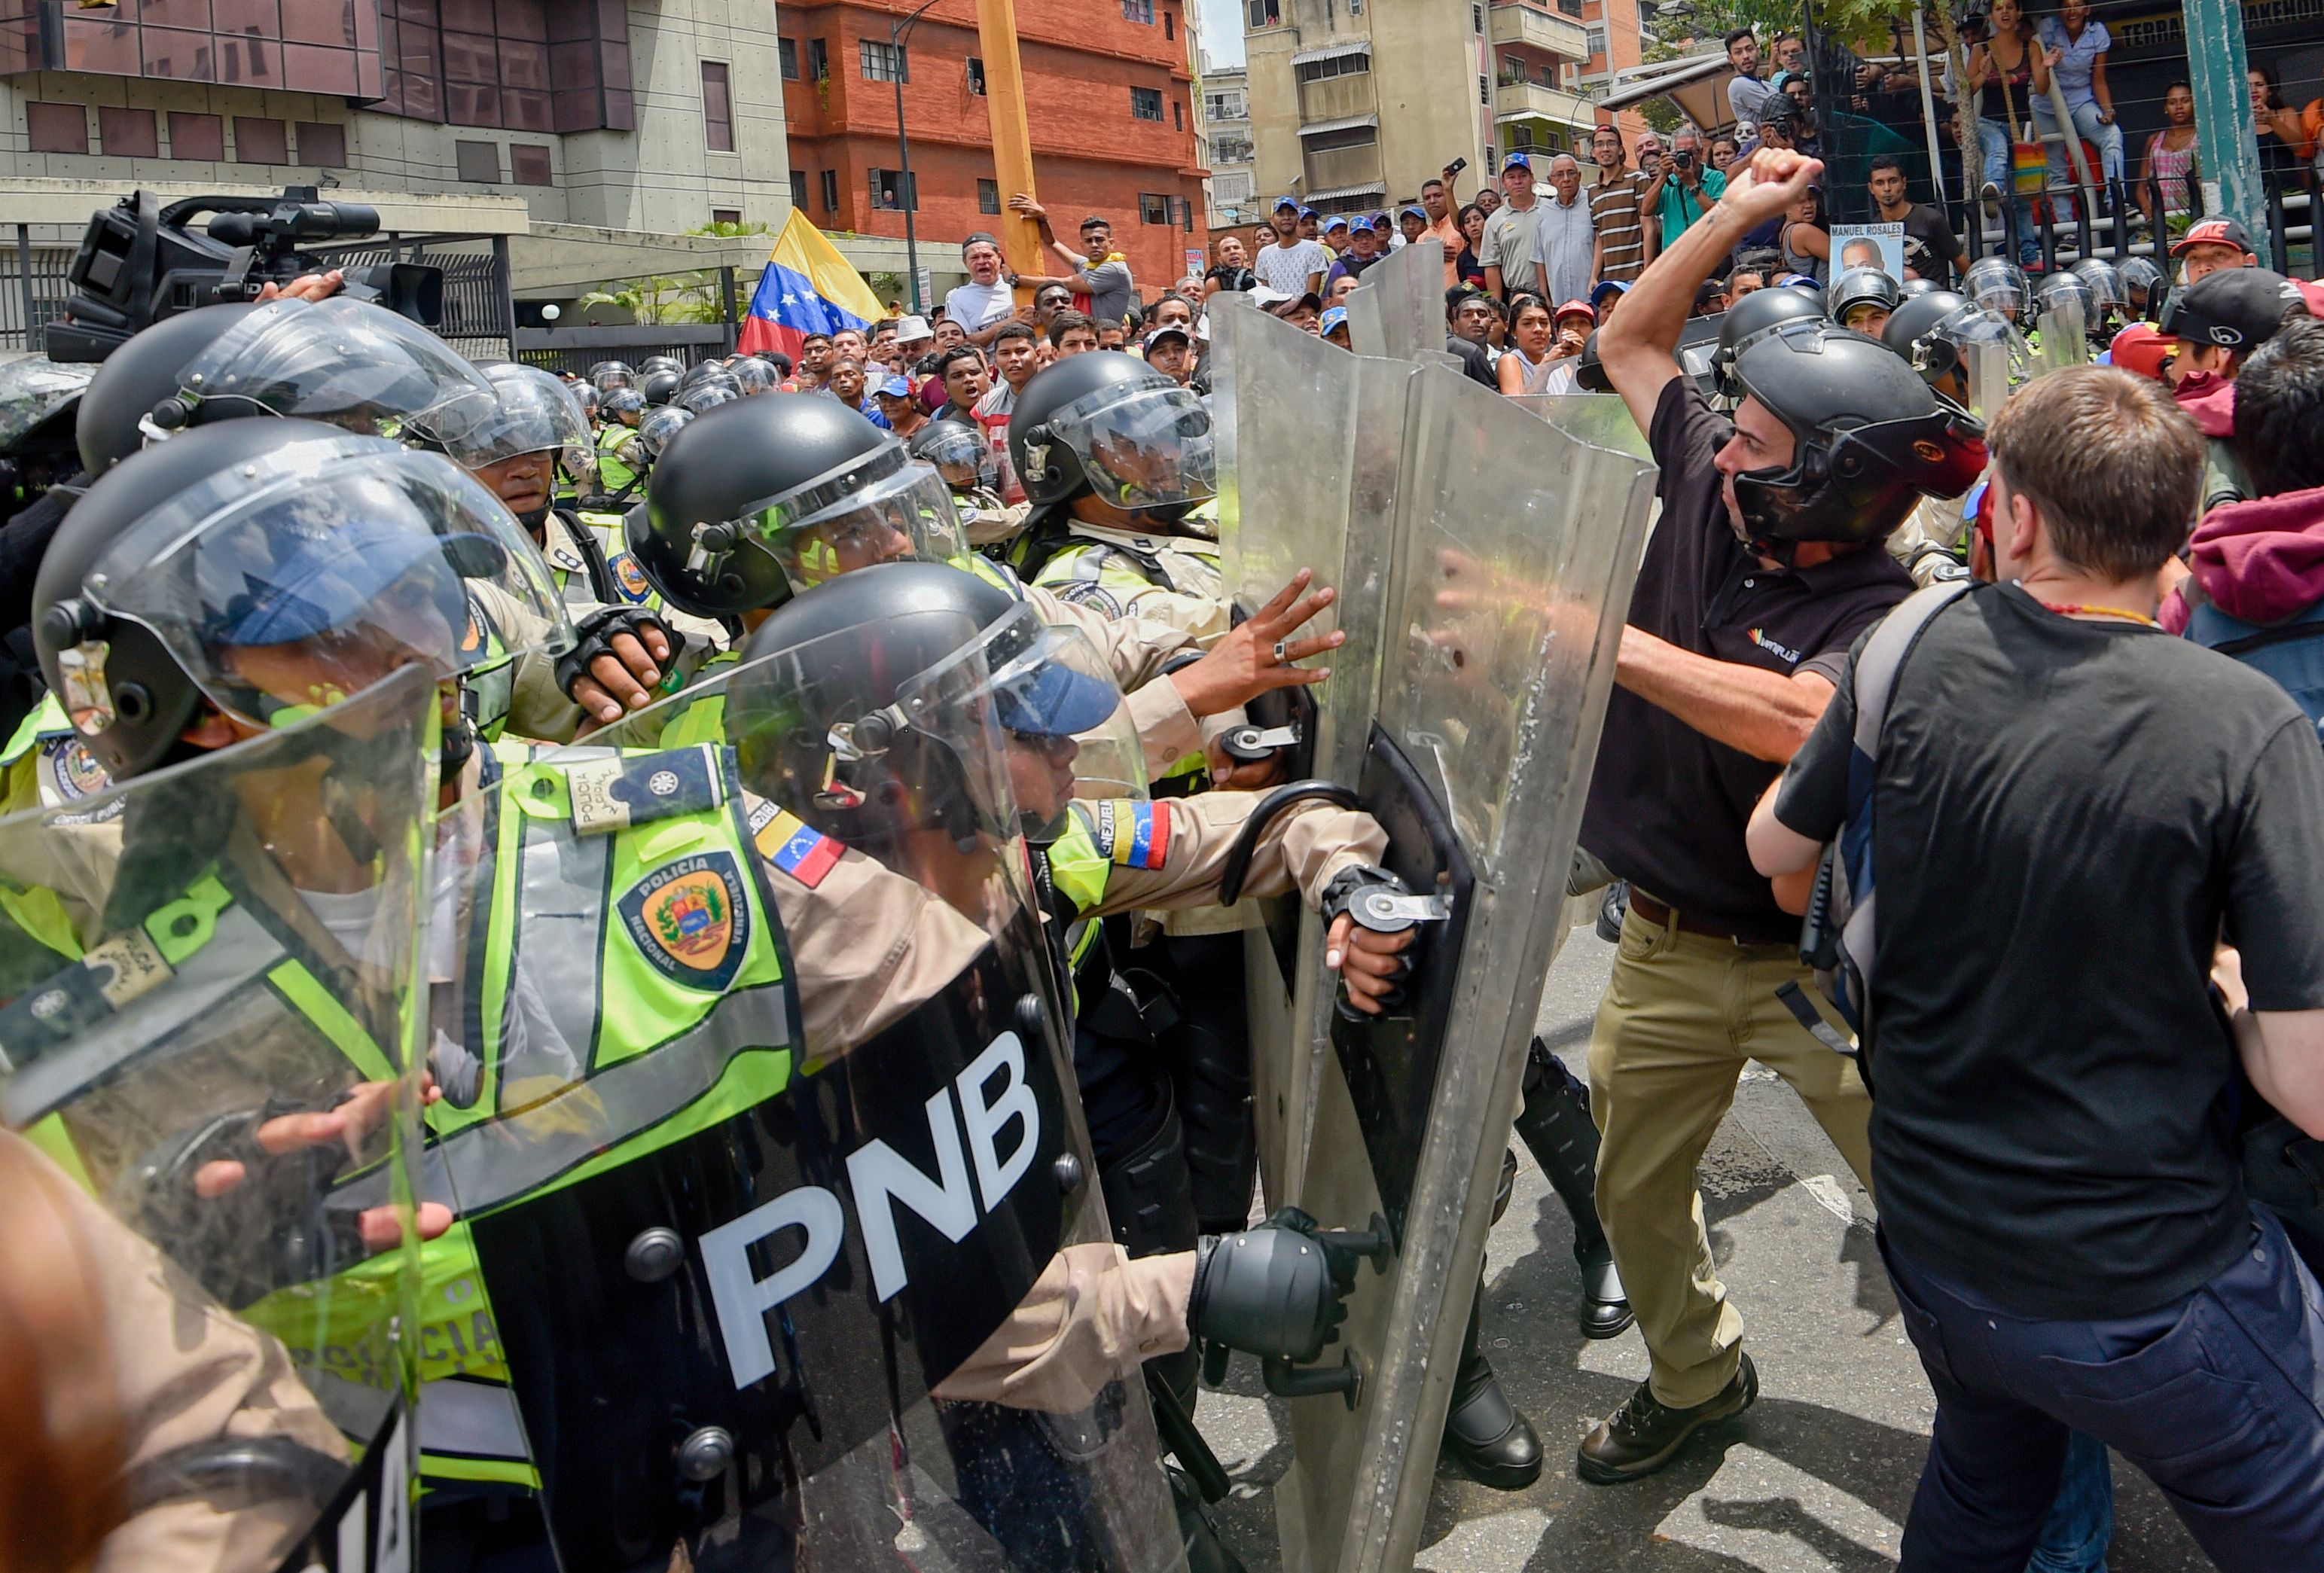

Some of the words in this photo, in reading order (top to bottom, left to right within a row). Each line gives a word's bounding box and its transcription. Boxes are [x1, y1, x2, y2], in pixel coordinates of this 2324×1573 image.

[2121, 15, 2185, 48] TERRA
[1831, 226, 1864, 236] MANUEL
[1866, 224, 1902, 236] ROSALES
[576, 772, 595, 823] POLICIA
[593, 769, 619, 815] NACIONAL
[638, 857, 709, 897] POLICÍA
[724, 870, 745, 945] VENEZUELA
[630, 915, 677, 972] NACIONAL
[697, 1030, 1041, 1391] PNB
